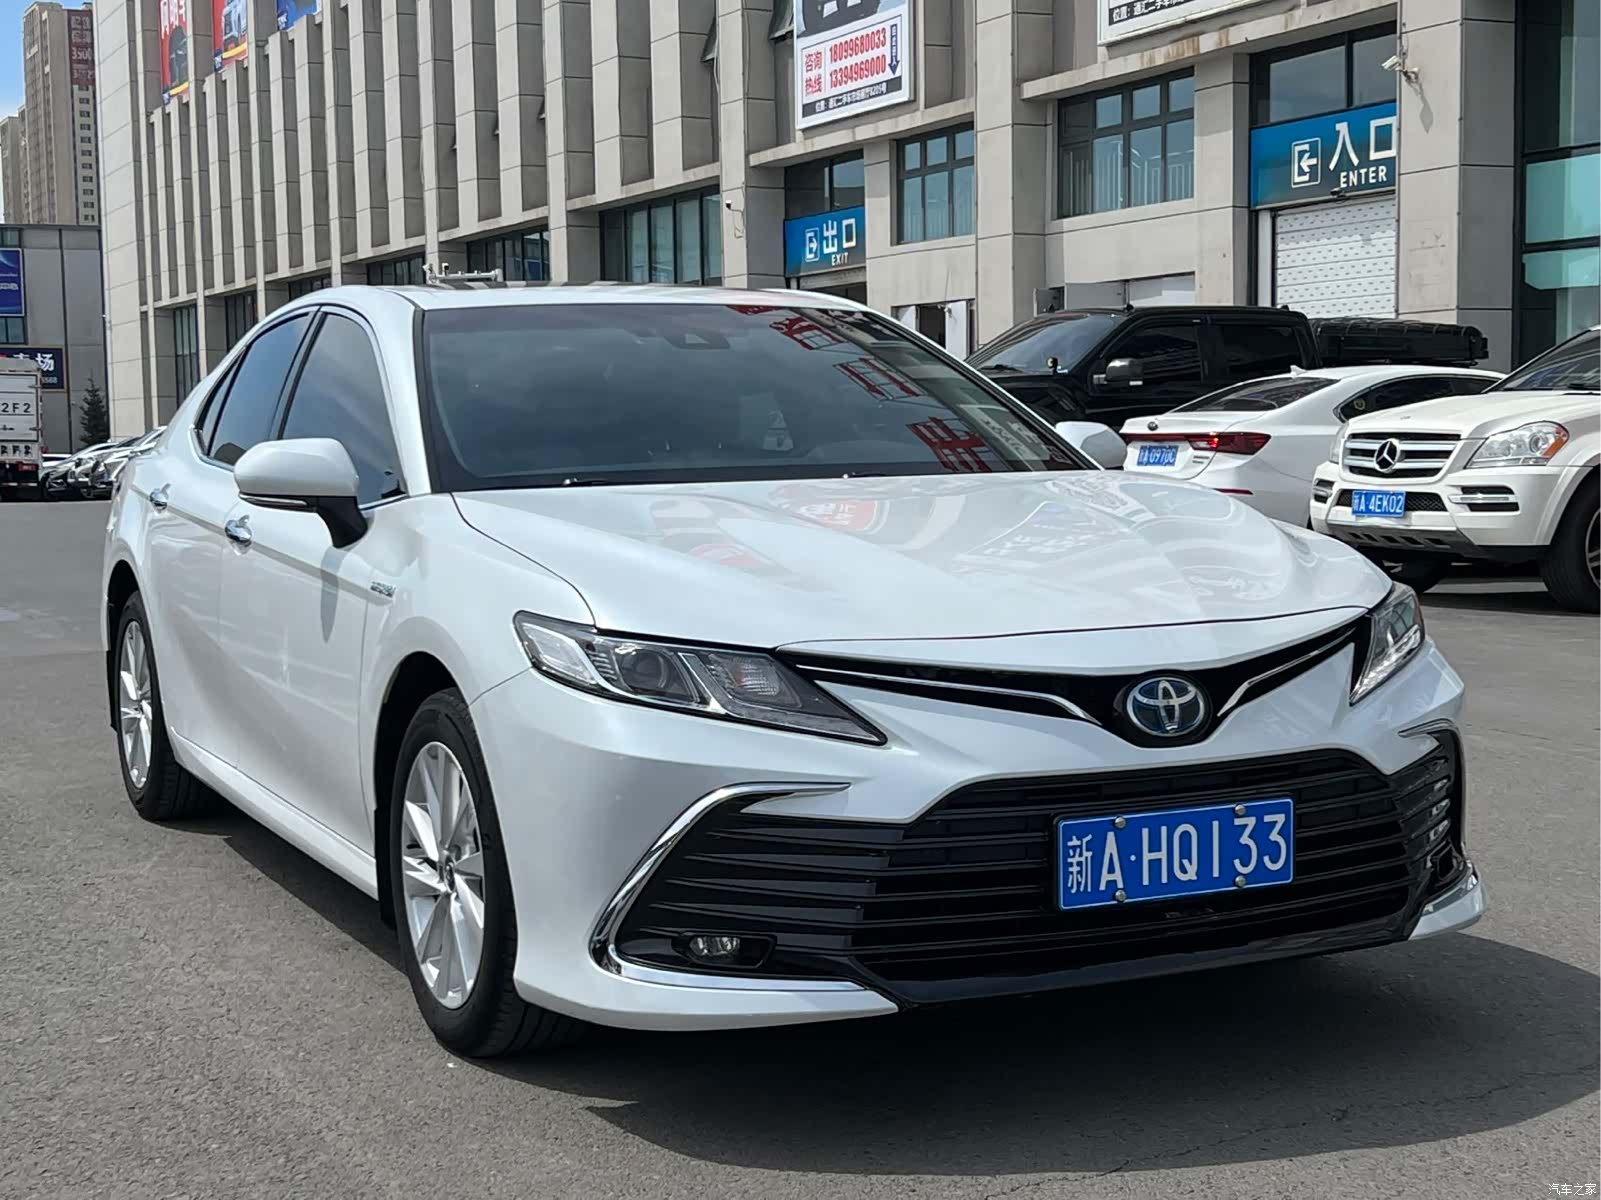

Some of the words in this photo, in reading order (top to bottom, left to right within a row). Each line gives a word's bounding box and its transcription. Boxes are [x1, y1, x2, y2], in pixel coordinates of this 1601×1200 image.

[829, 27, 886, 63] 18099680033
[805, 51, 823, 72] 咨询
[829, 54, 886, 89] 13394969000
[804, 74, 823, 95] 热线
[1328, 116, 1397, 171] 入口
[1340, 165, 1387, 188] ENTER
[823, 218, 856, 254] 出口
[831, 252, 848, 266] EXIT
